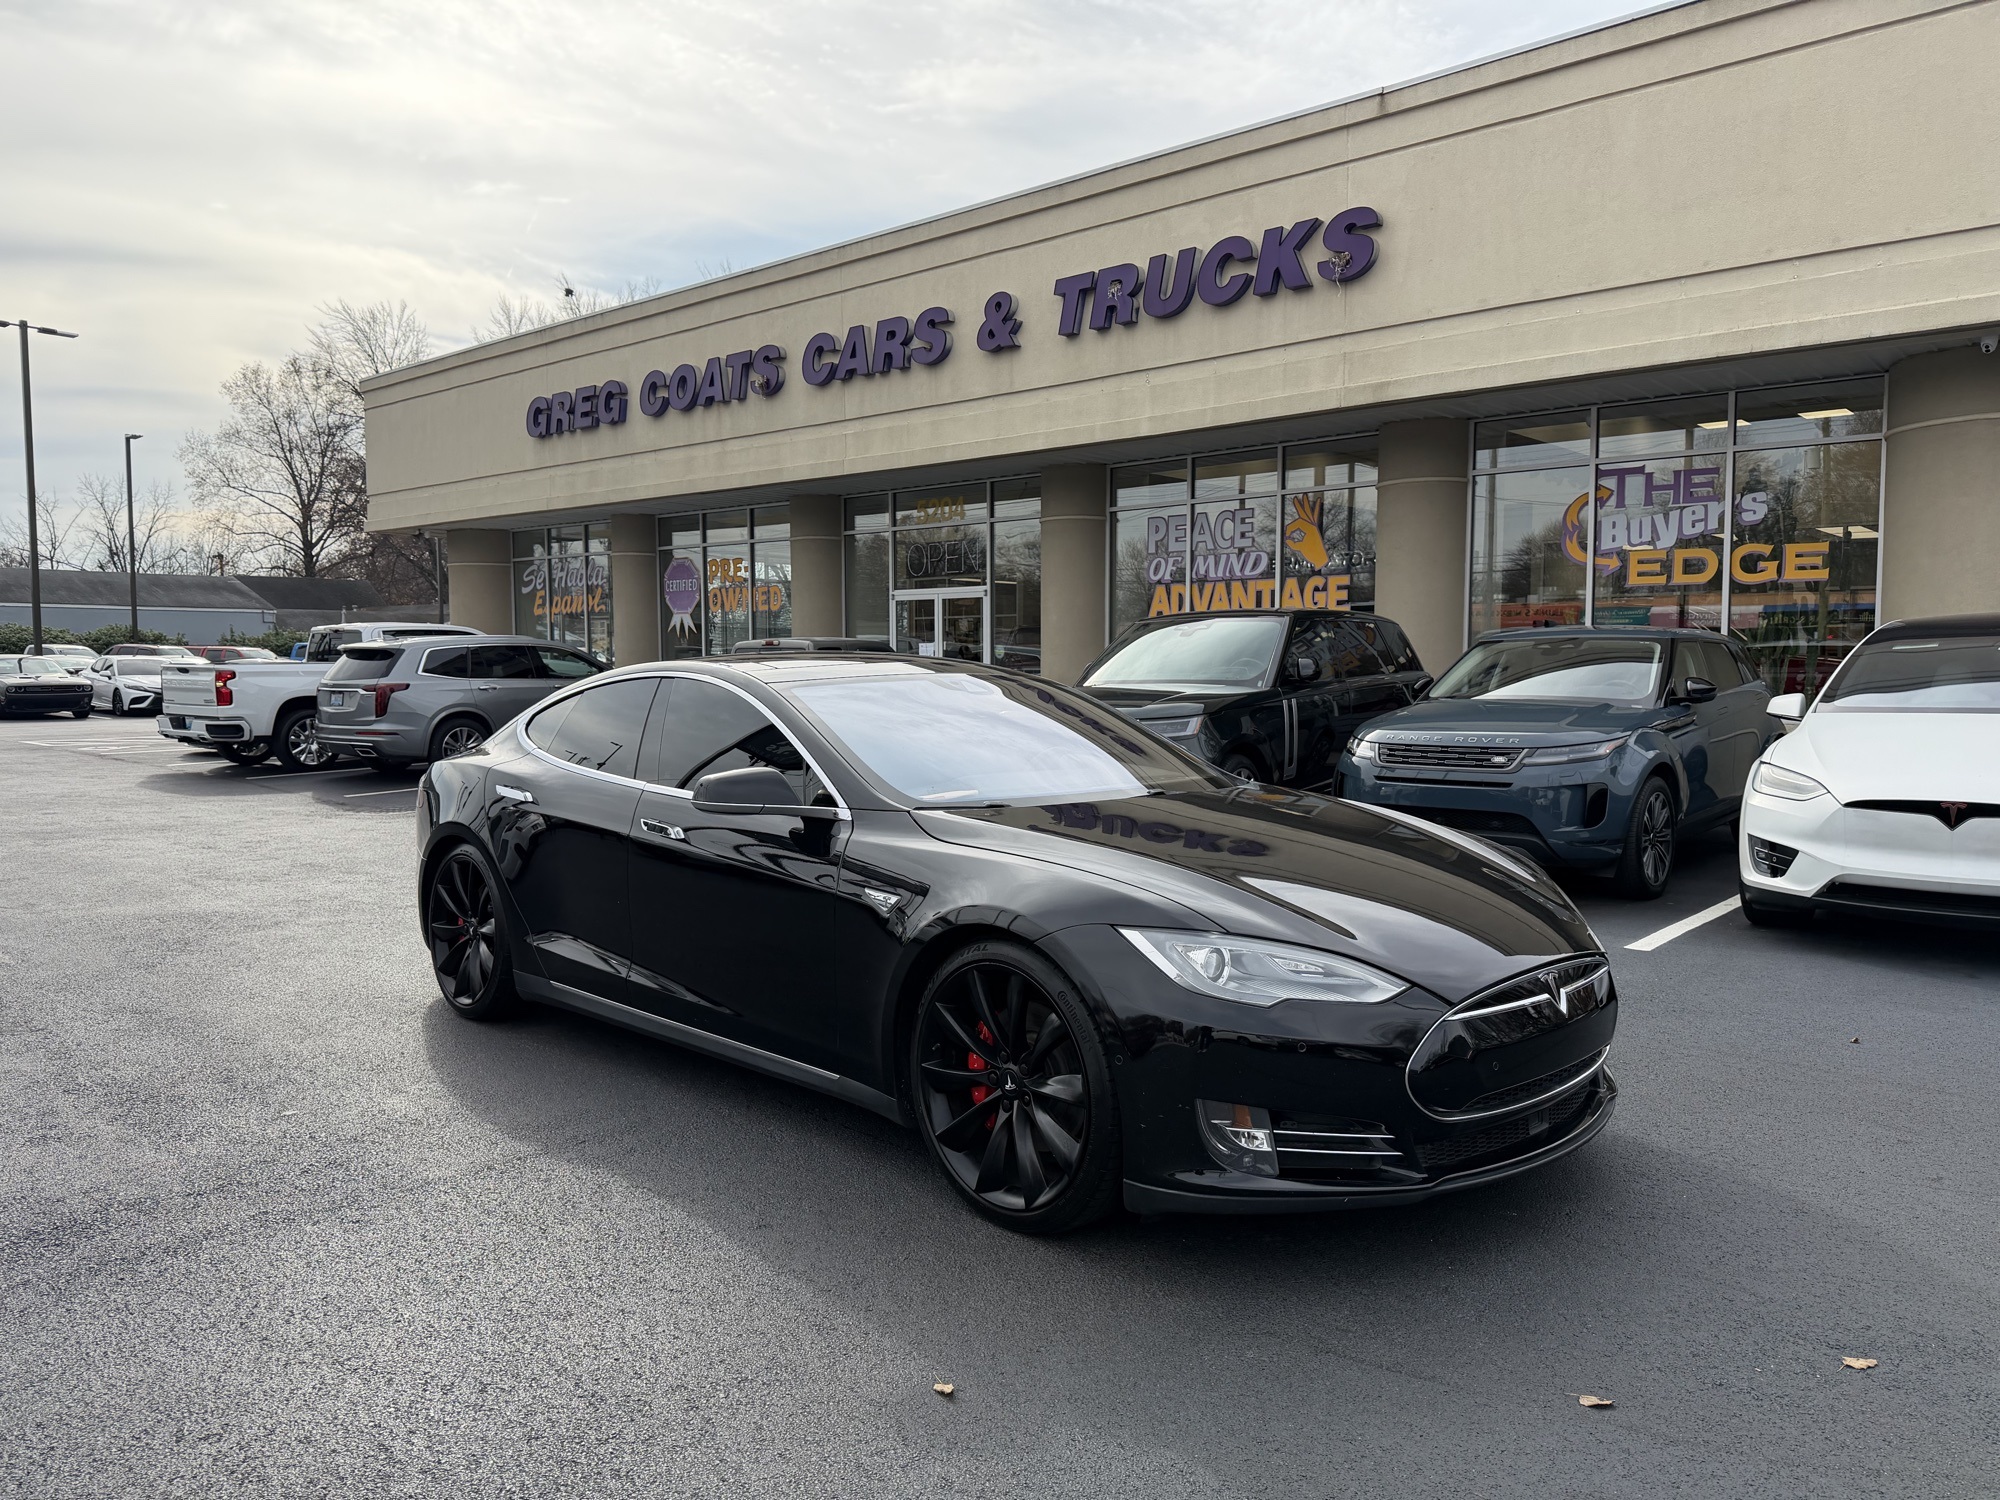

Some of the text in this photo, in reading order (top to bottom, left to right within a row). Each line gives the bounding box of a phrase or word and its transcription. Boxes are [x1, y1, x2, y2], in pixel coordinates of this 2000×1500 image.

[526, 206, 1383, 438] GREG COATS CARS & TRUCKS
[1597, 465, 1720, 509] THE
[916, 496, 966, 524] 5204
[1148, 508, 1254, 553] PEACE
[708, 557, 749, 584] PRE-
[907, 540, 979, 577] OPEN
[1148, 551, 1269, 583] OF MIND
[1626, 541, 1830, 587] EDGE
[521, 563, 545, 594] Se
[665, 577, 698, 592] CERTIFIED
[1148, 574, 1351, 617] ADVANTAGE
[1386, 733, 1520, 744] RANGE ROVER
[1057, 990, 1091, 1044] Continental
